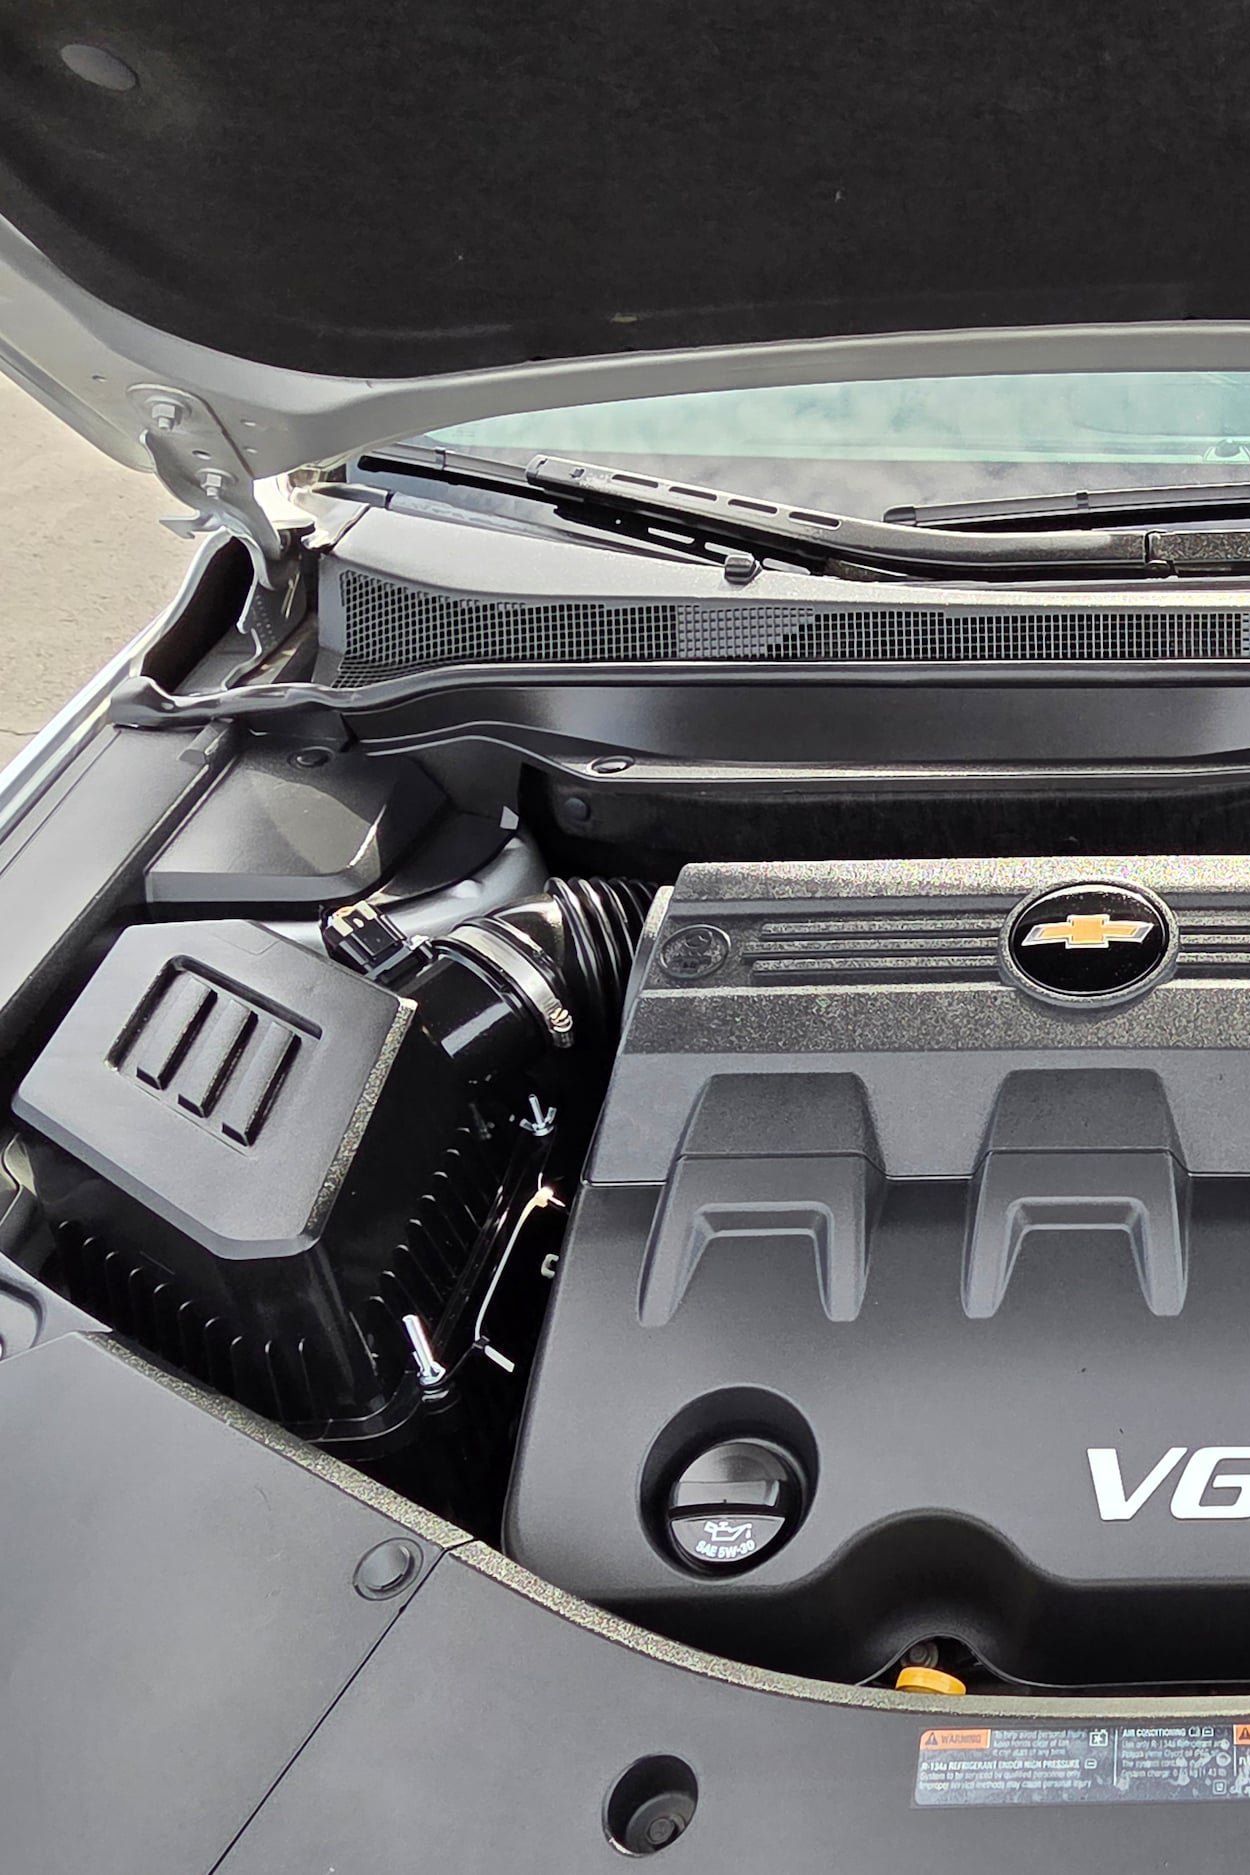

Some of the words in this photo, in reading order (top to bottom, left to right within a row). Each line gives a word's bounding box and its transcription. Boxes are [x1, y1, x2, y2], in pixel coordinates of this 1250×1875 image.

[695, 1539, 718, 1559] SAE
[717, 1539, 756, 1560] 5W-30
[1122, 1729, 1135, 1737] AIR
[941, 1734, 982, 1743] WARNING
[1042, 1760, 1080, 1768] PRESSURE
